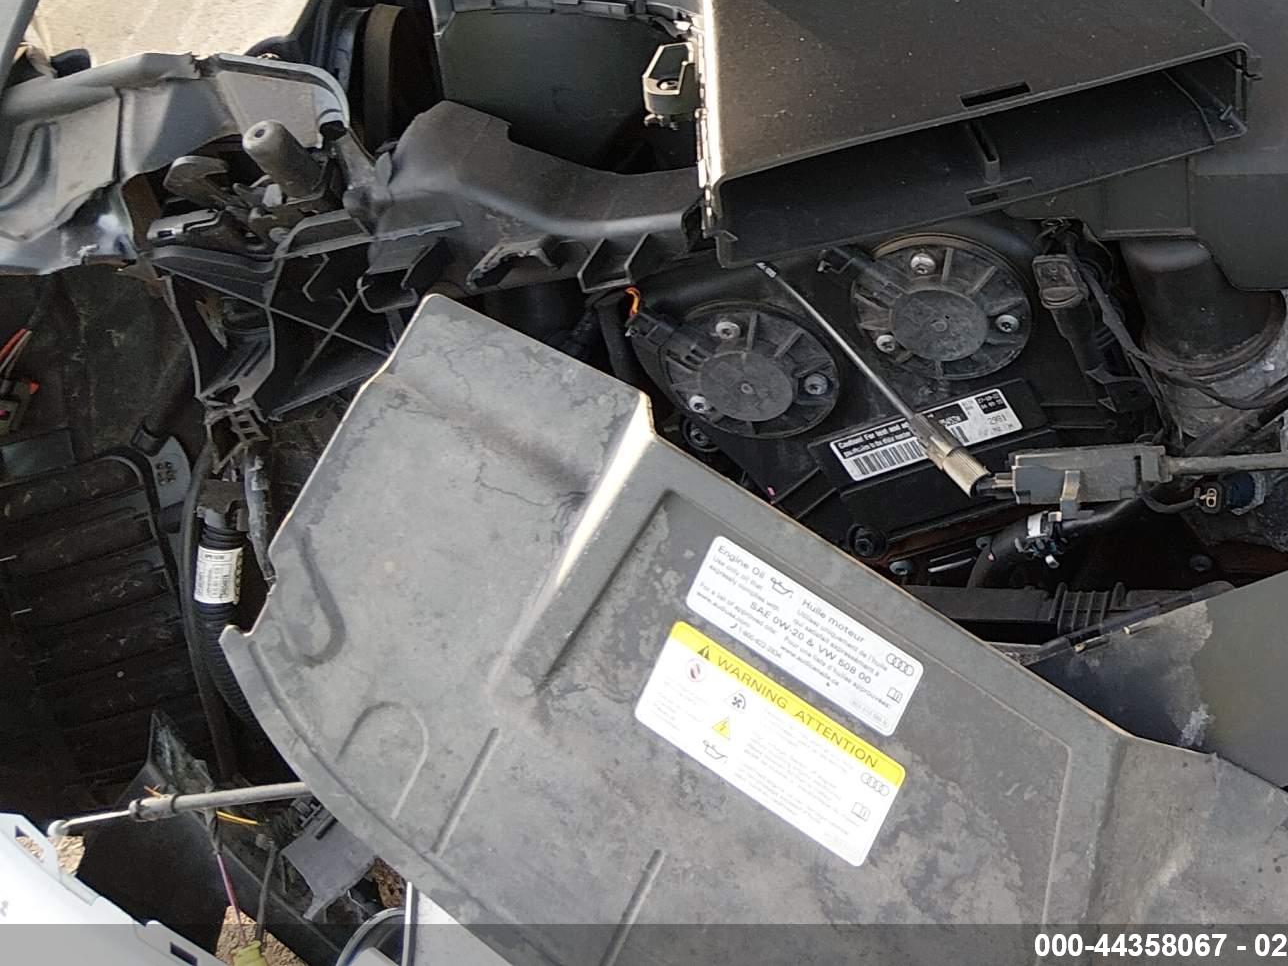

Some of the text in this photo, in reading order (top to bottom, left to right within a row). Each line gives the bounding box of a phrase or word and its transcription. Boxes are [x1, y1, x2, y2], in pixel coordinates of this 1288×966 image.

[717, 545, 766, 580] Engine Oil
[749, 600, 873, 685] SAE 0W-20 & VW 508 00
[802, 598, 865, 644] Huile moteur
[716, 655, 790, 711] WARNING
[793, 707, 879, 770] ATTENTION
